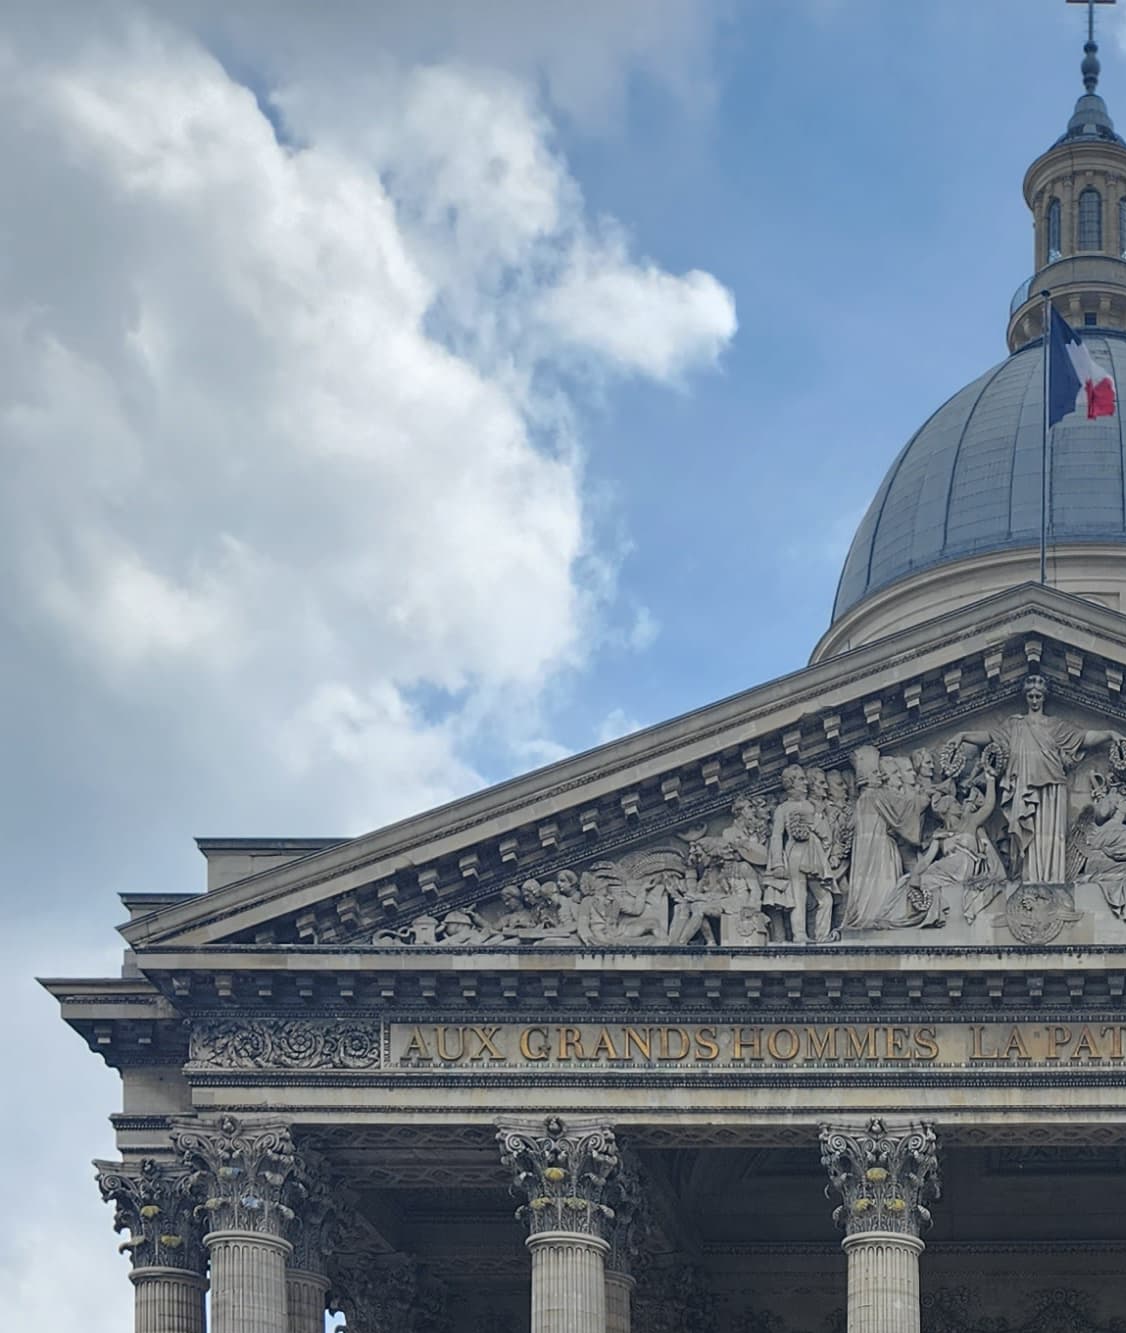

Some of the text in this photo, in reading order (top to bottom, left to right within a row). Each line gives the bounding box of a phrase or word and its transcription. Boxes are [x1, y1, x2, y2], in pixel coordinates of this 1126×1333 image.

[400, 1025, 502, 1061] AUX
[519, 1025, 719, 1061] GRANDS
[731, 1025, 939, 1060] HOMMES
[969, 1025, 1030, 1059] LA
